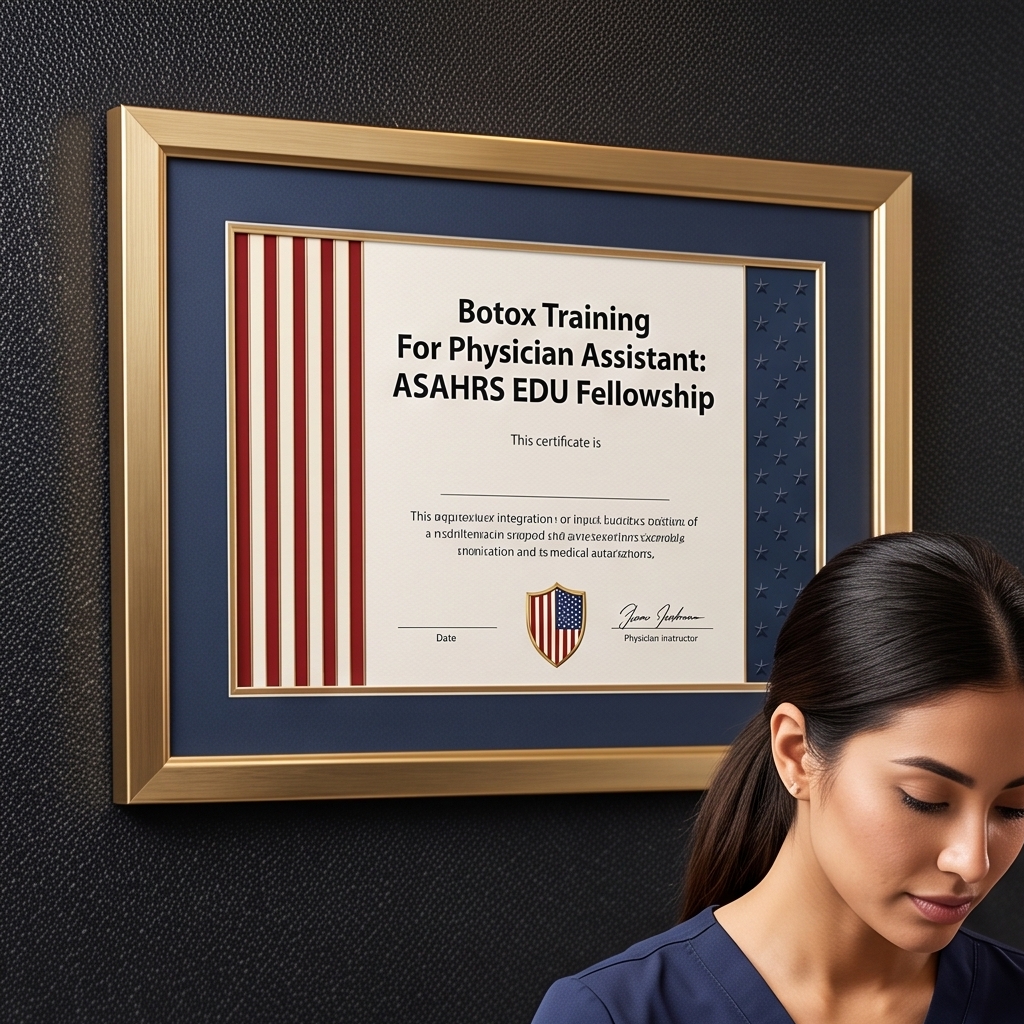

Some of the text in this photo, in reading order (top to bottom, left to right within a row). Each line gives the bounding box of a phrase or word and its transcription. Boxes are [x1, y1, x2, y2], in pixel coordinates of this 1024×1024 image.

[458, 298, 650, 338] Botox Training
[397, 334, 706, 372] For Physician Assistant:
[393, 373, 715, 416] ASAHRS EDU Fellowship
[511, 433, 601, 449] This certificate is
[410, 510, 432, 522] This
[497, 513, 553, 526] integration
[560, 516, 571, 525] or
[687, 516, 698, 527] of
[517, 547, 536, 557] and
[550, 547, 589, 558] medical
[436, 632, 457, 644] Date
